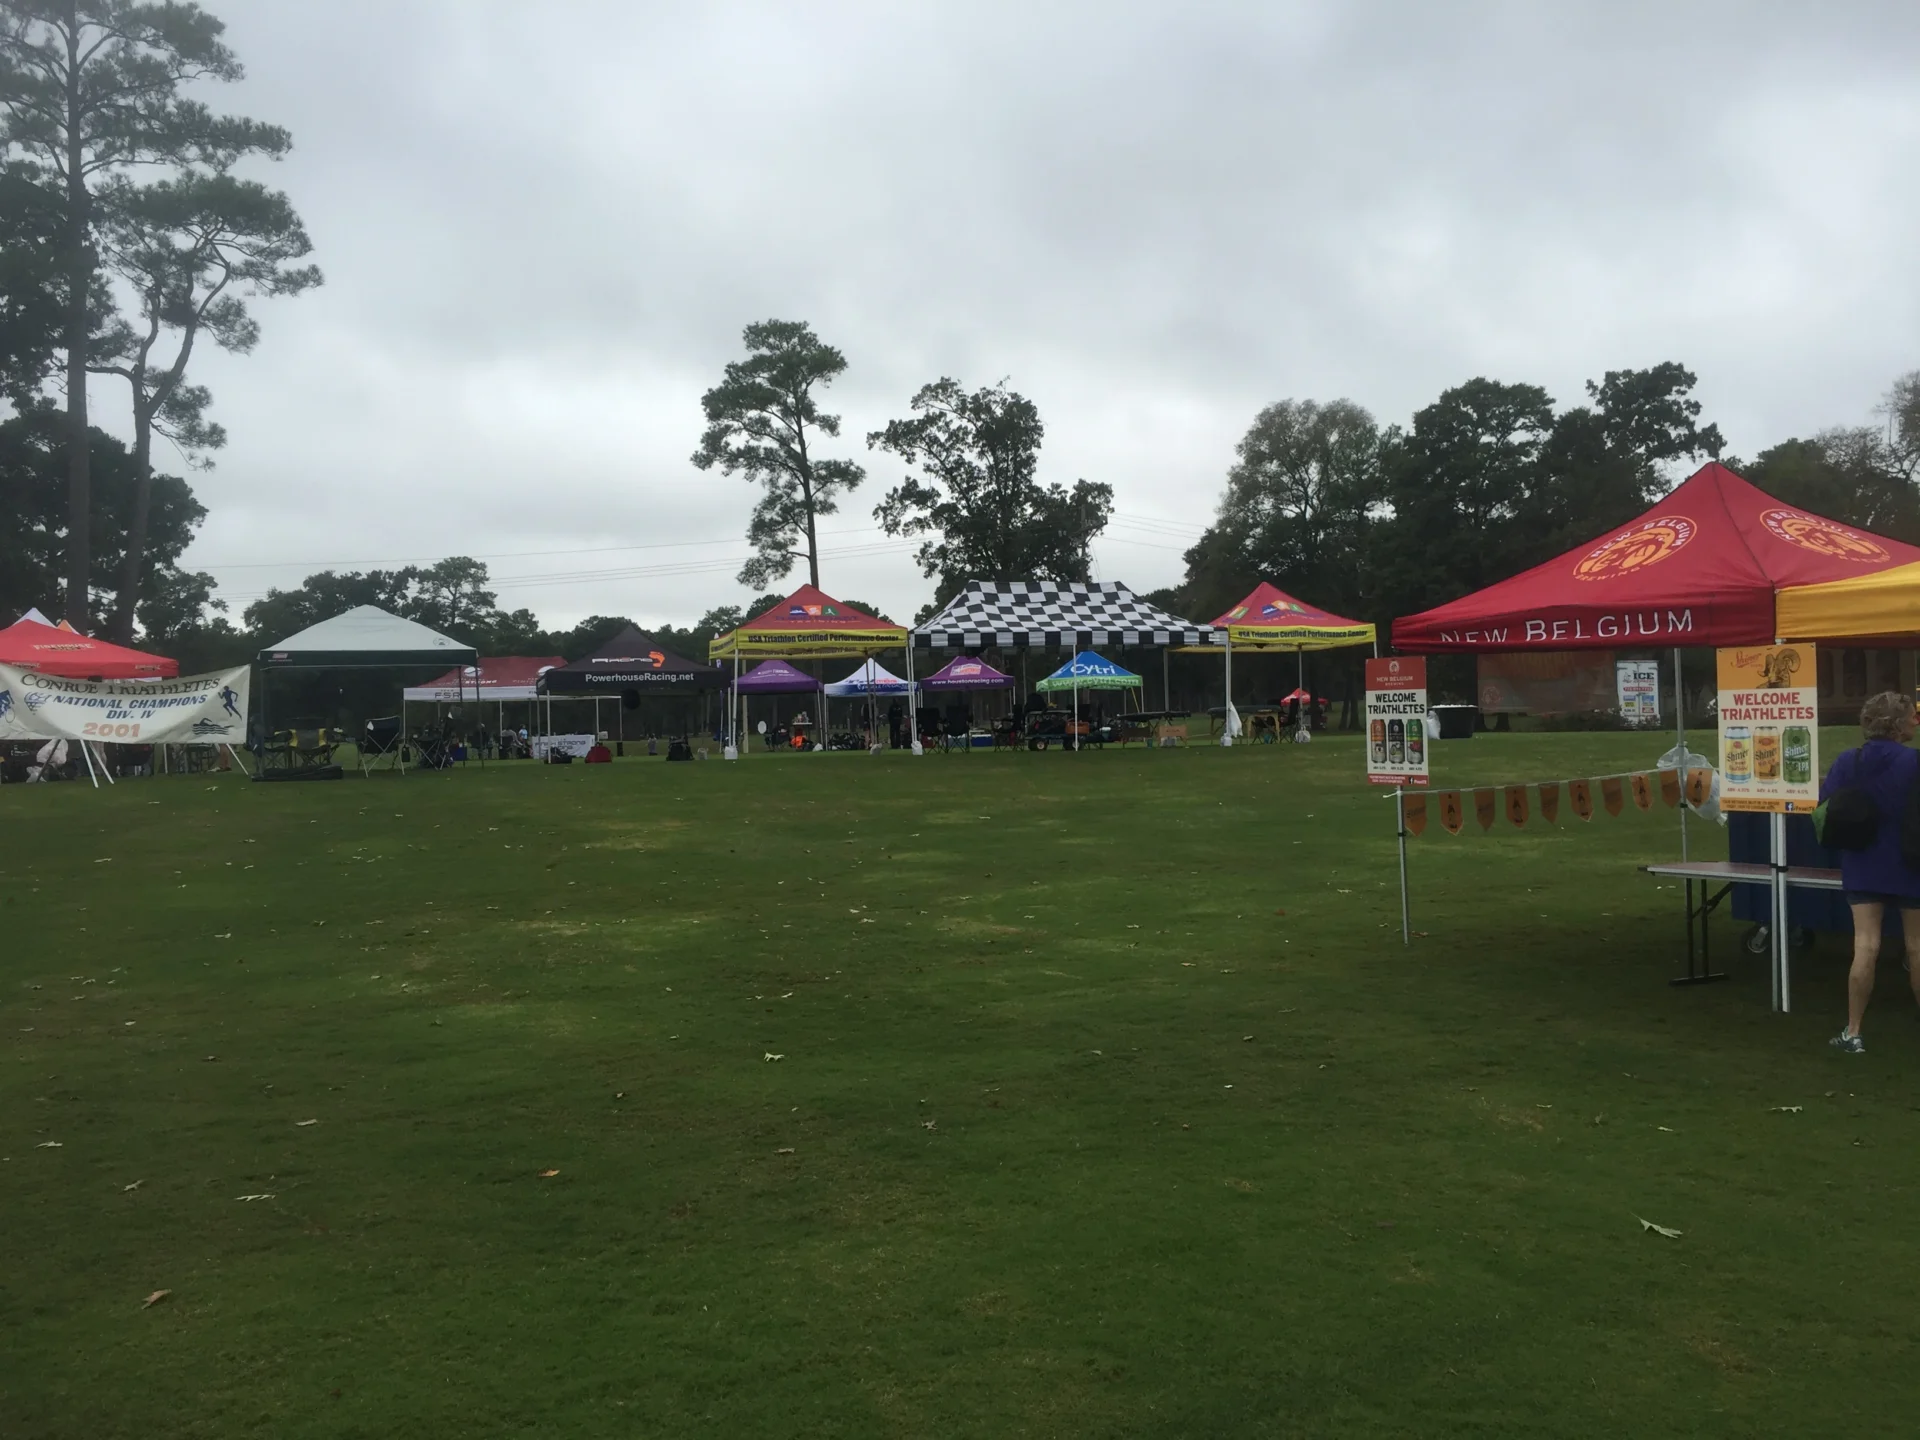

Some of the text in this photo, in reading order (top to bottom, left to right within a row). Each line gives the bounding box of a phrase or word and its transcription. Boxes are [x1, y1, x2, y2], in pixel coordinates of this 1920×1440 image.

[1590, 518, 1690, 558] NEW BELGIUM
[1525, 608, 1693, 642] BELGIUM
[764, 634, 796, 643] Triathlon
[797, 633, 829, 643] Certified
[829, 633, 875, 642] Performance
[1280, 630, 1307, 638] Certified
[1308, 630, 1347, 638] Performance
[1070, 663, 1116, 675] Cytri
[585, 672, 694, 683] PowerhouseRacing.net
[931, 678, 1005, 686] www.houstonracing.com
[1633, 672, 1655, 680] ICE
[20, 673, 99, 694] CONROE
[54, 694, 208, 709] NATIONAL CHAMPIONS
[1375, 692, 1417, 703] WELCOME
[1733, 692, 1800, 706] WELCOME
[106, 709, 156, 719] DIV. IV
[1368, 704, 1425, 714] TRIATHLETES
[1721, 707, 1815, 721] TRIATHLETES
[82, 722, 141, 738] 2001
[1726, 749, 1750, 762] Shiner
[1755, 747, 1778, 761] Shiner
